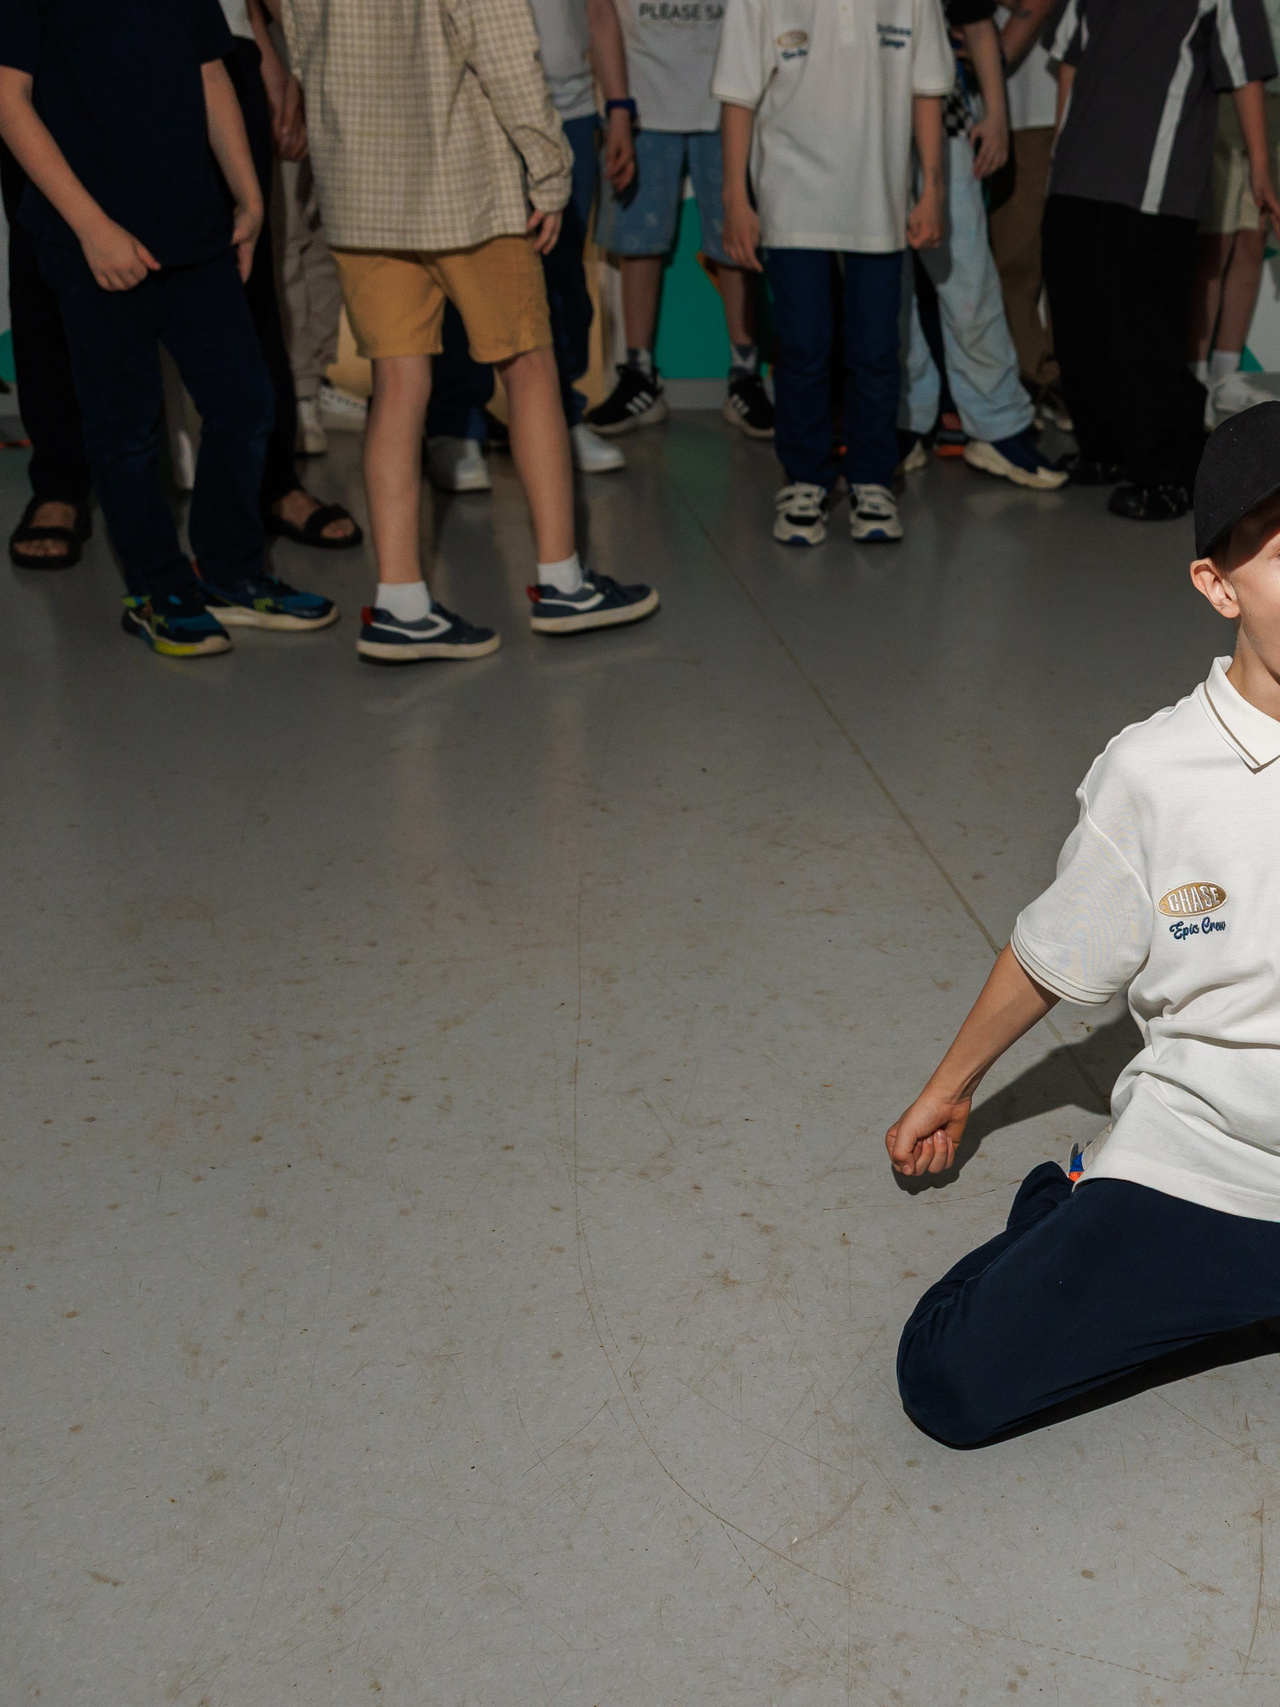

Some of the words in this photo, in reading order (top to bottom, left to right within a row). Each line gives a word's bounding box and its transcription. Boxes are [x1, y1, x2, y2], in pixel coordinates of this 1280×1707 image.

[639, 3, 699, 20] PLEASE
[1167, 885, 1221, 913] CHASE
[1168, 920, 1200, 940] Epic
[1201, 916, 1227, 935] Crew
